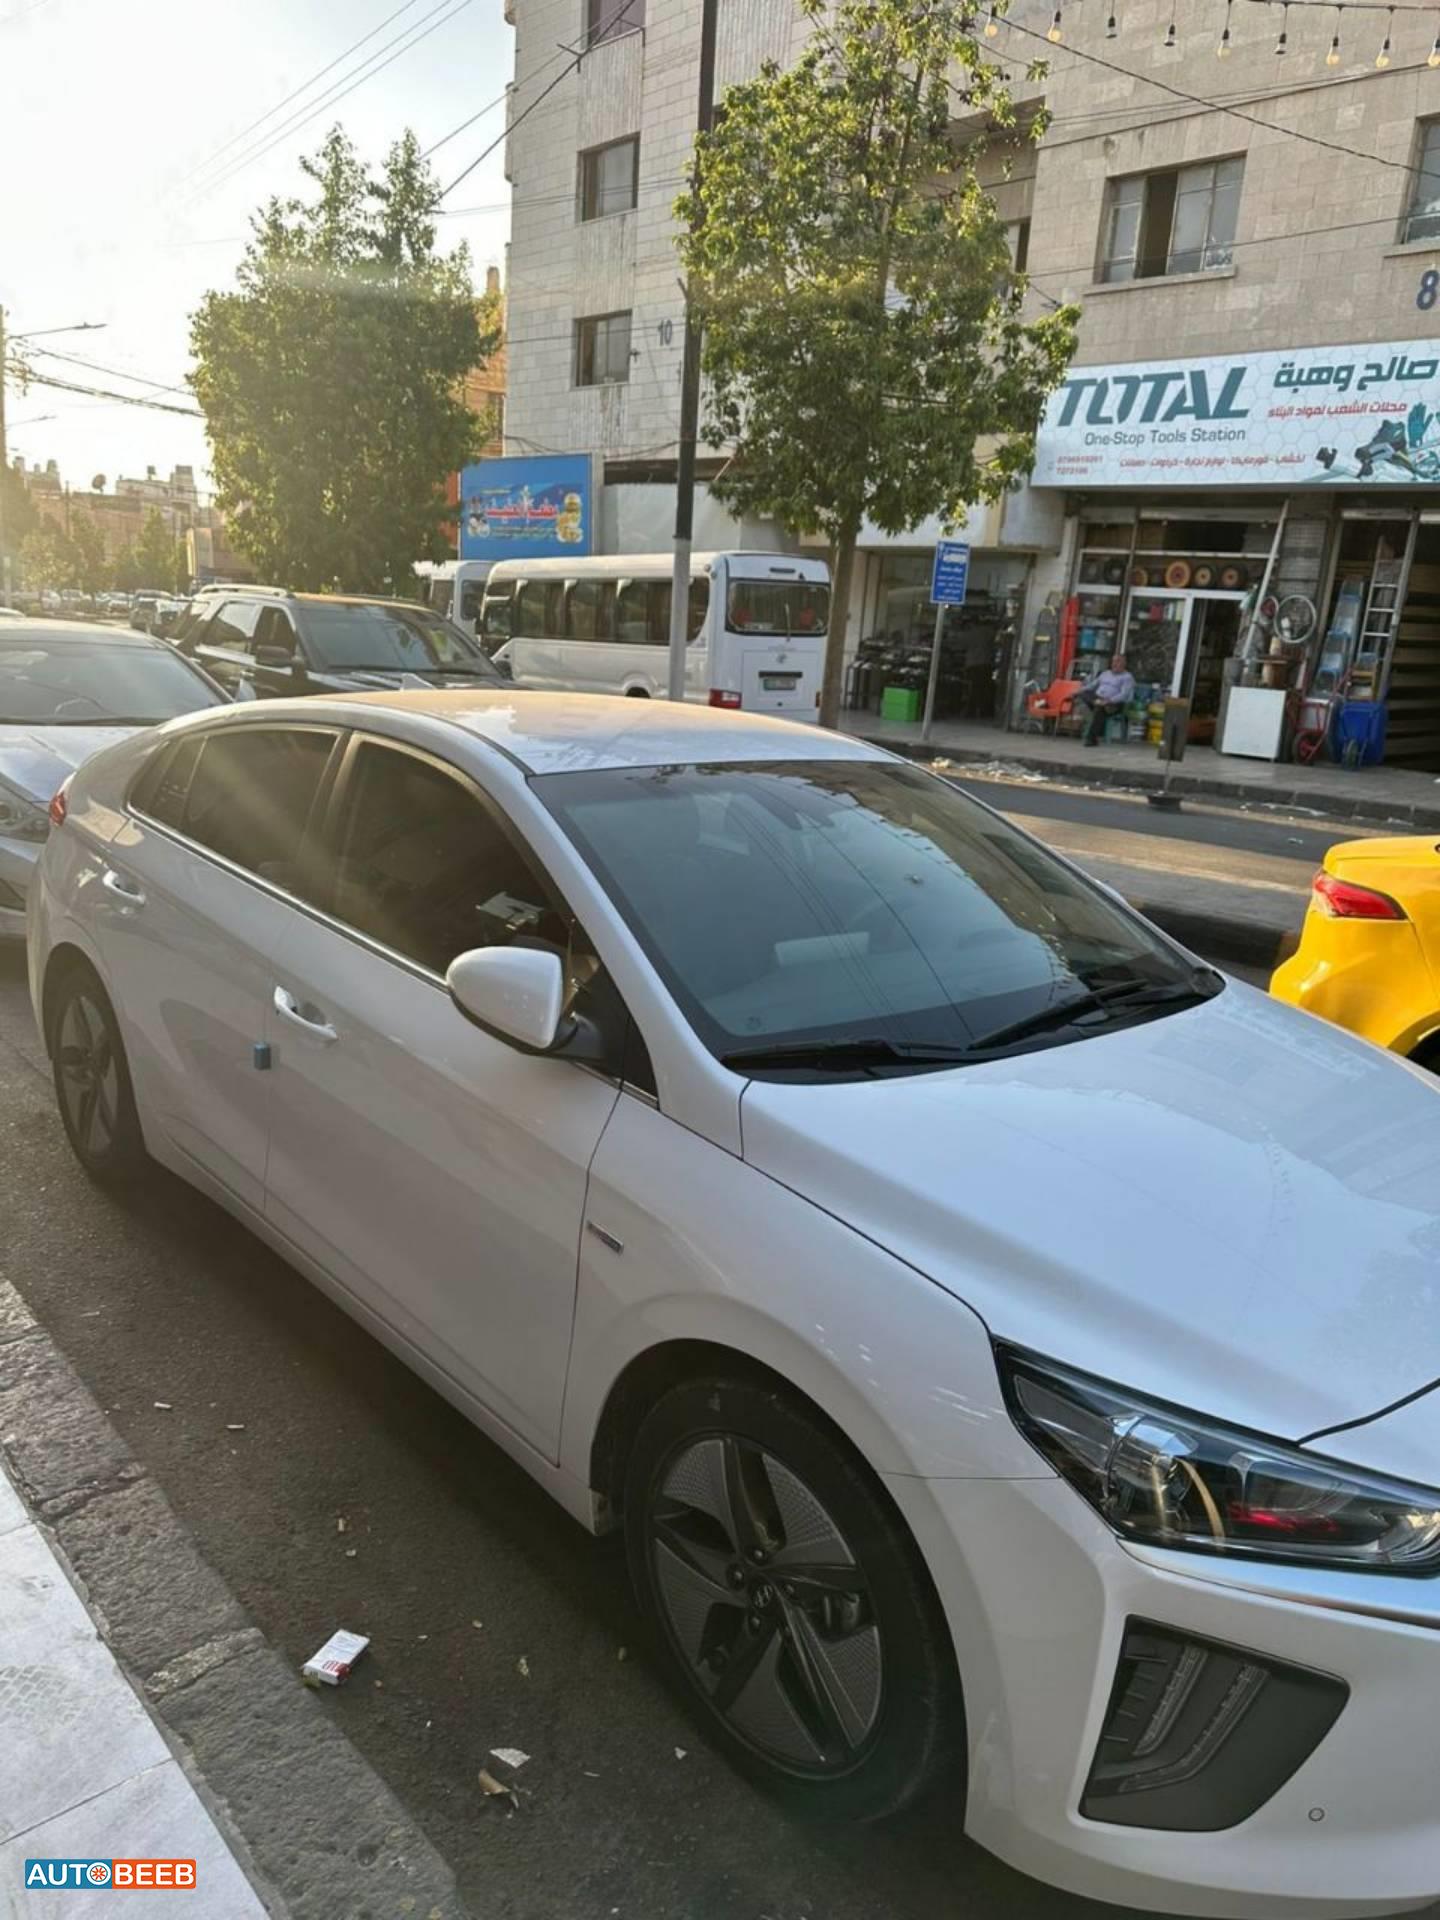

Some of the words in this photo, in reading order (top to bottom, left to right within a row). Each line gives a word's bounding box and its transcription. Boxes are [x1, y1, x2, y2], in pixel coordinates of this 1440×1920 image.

[658, 320, 673, 347] 10
[1273, 362, 1355, 394] وهبة
[1356, 356, 1439, 391] صالح
[1057, 366, 1250, 426] TOTAL
[1369, 402, 1408, 414] محلات
[1295, 405, 1326, 418] لمواد
[1084, 431, 1145, 448] One-Stop
[1150, 429, 1186, 443] Tools
[1190, 427, 1246, 443] Station
